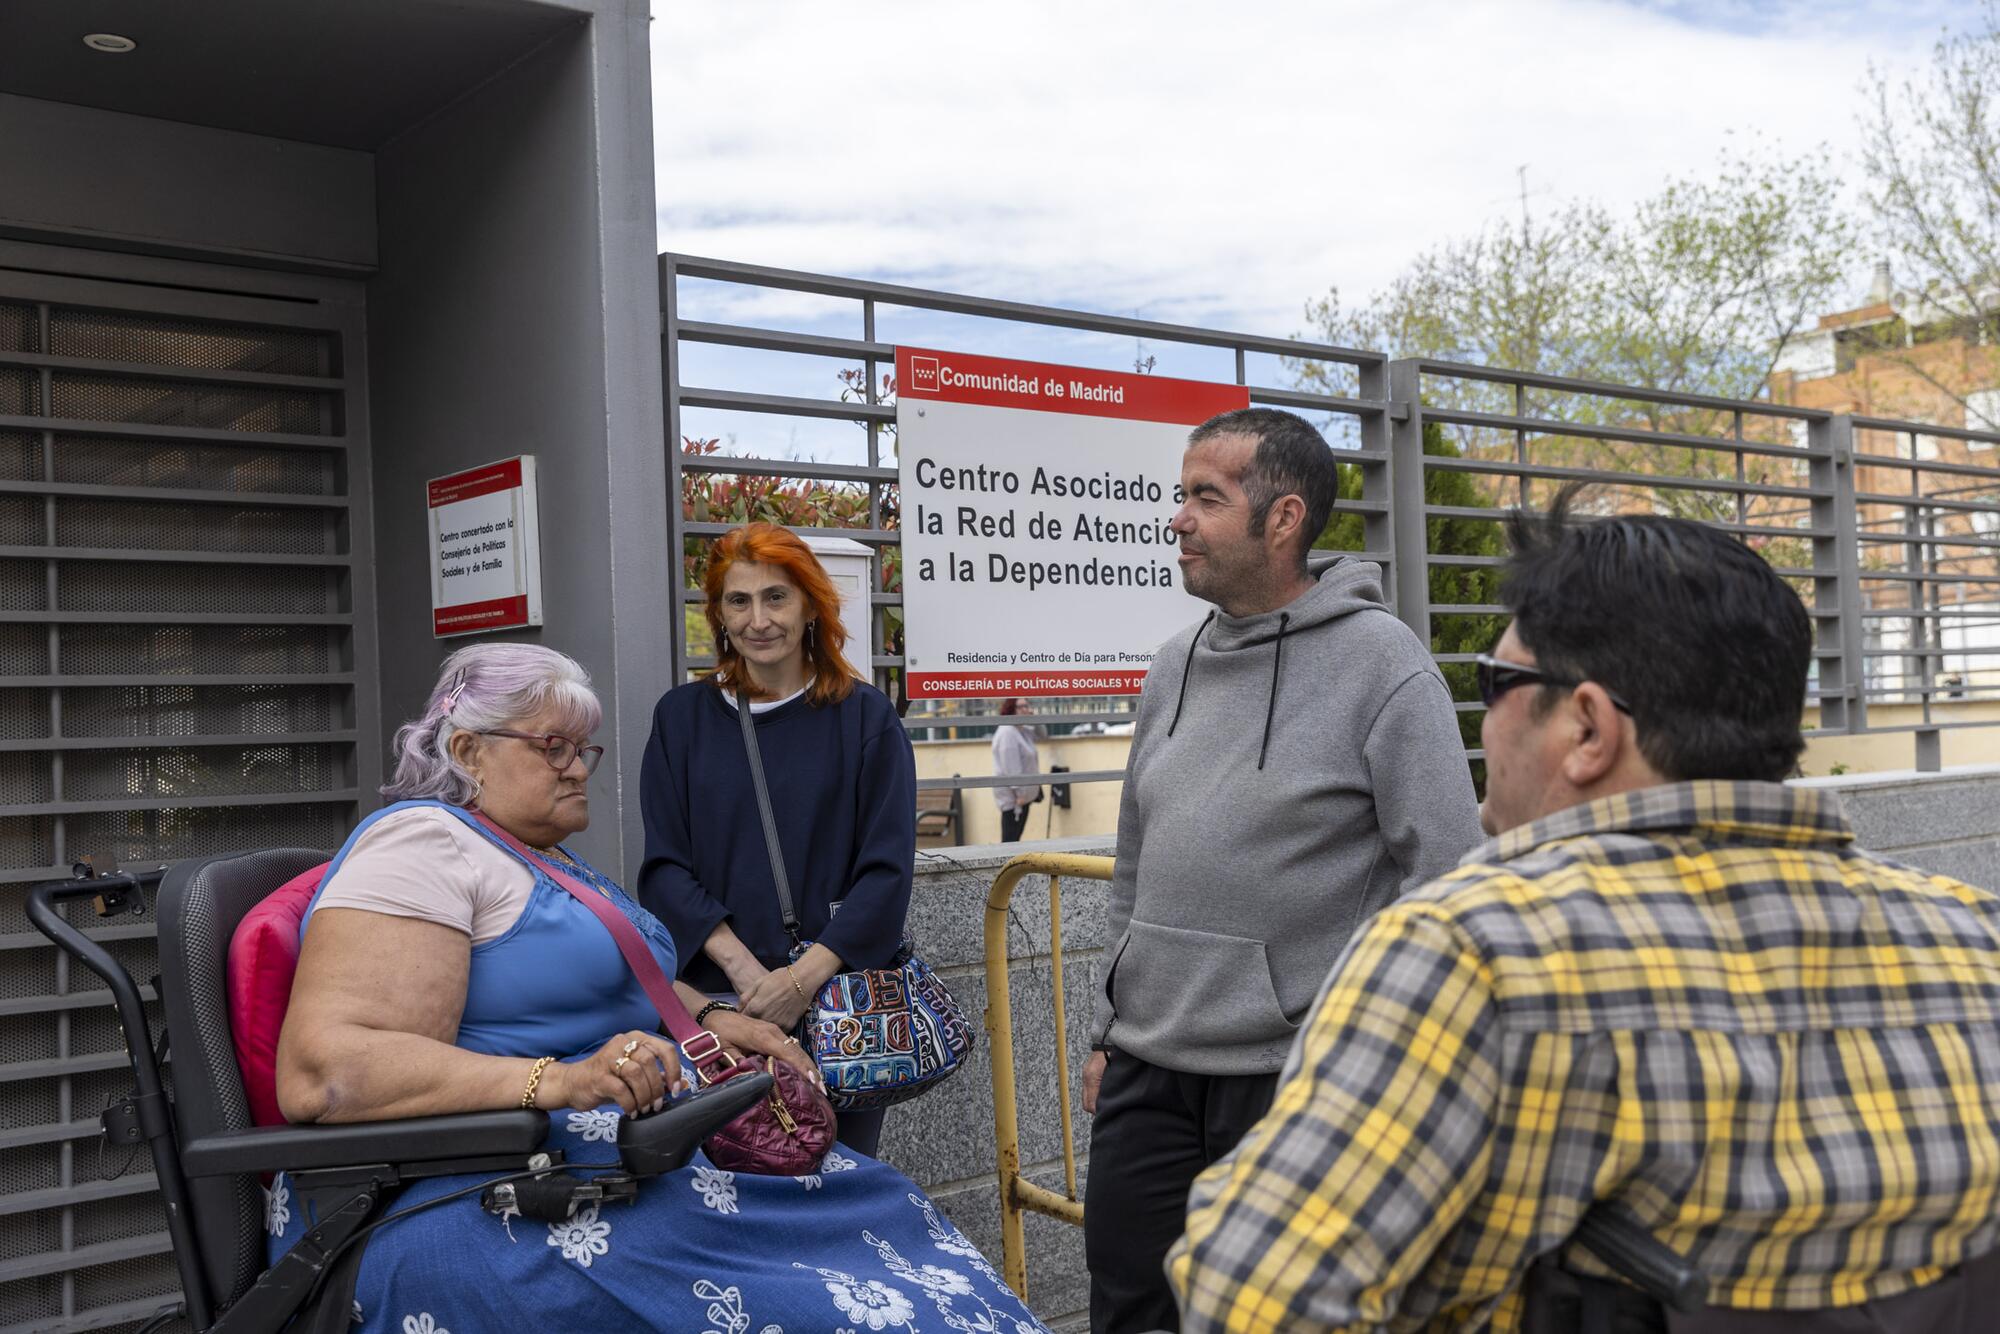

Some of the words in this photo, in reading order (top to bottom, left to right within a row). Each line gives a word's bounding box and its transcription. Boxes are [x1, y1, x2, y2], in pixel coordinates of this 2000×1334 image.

[940, 366, 1038, 394] Comunidad
[1044, 378, 1064, 398] de
[1069, 381, 1124, 404] Madrid
[916, 457, 1019, 494] Centro
[1030, 466, 1161, 503] Asociado
[1173, 484, 1185, 505] a
[440, 532, 459, 543] Centro
[461, 523, 493, 538] concertado
[495, 521, 506, 531] con
[507, 517, 514, 528] la
[918, 504, 943, 535] la
[958, 506, 1015, 538] Red
[1028, 511, 1062, 540] de
[1073, 513, 1177, 546] Atenció
[473, 544, 480, 554] de
[441, 565, 464, 578] Sociales
[466, 567, 471, 576] y
[472, 562, 480, 573] de
[482, 558, 502, 571] Familia
[919, 557, 935, 581] a
[949, 552, 974, 582] la
[988, 553, 1172, 591] Dependencia
[947, 652, 1008, 664] Residencia
[1010, 654, 1017, 665] y
[1020, 652, 1056, 664] Centro
[1058, 652, 1071, 663] de
[1094, 654, 1116, 665] para
[1119, 652, 1155, 662] Person
[922, 678, 993, 691] CONSEJERÍA
[997, 679, 1012, 690] DE
[1015, 676, 1069, 689] POLÍTICAS
[1072, 678, 1122, 689] SOCIALES
[1124, 678, 1131, 688] Y
